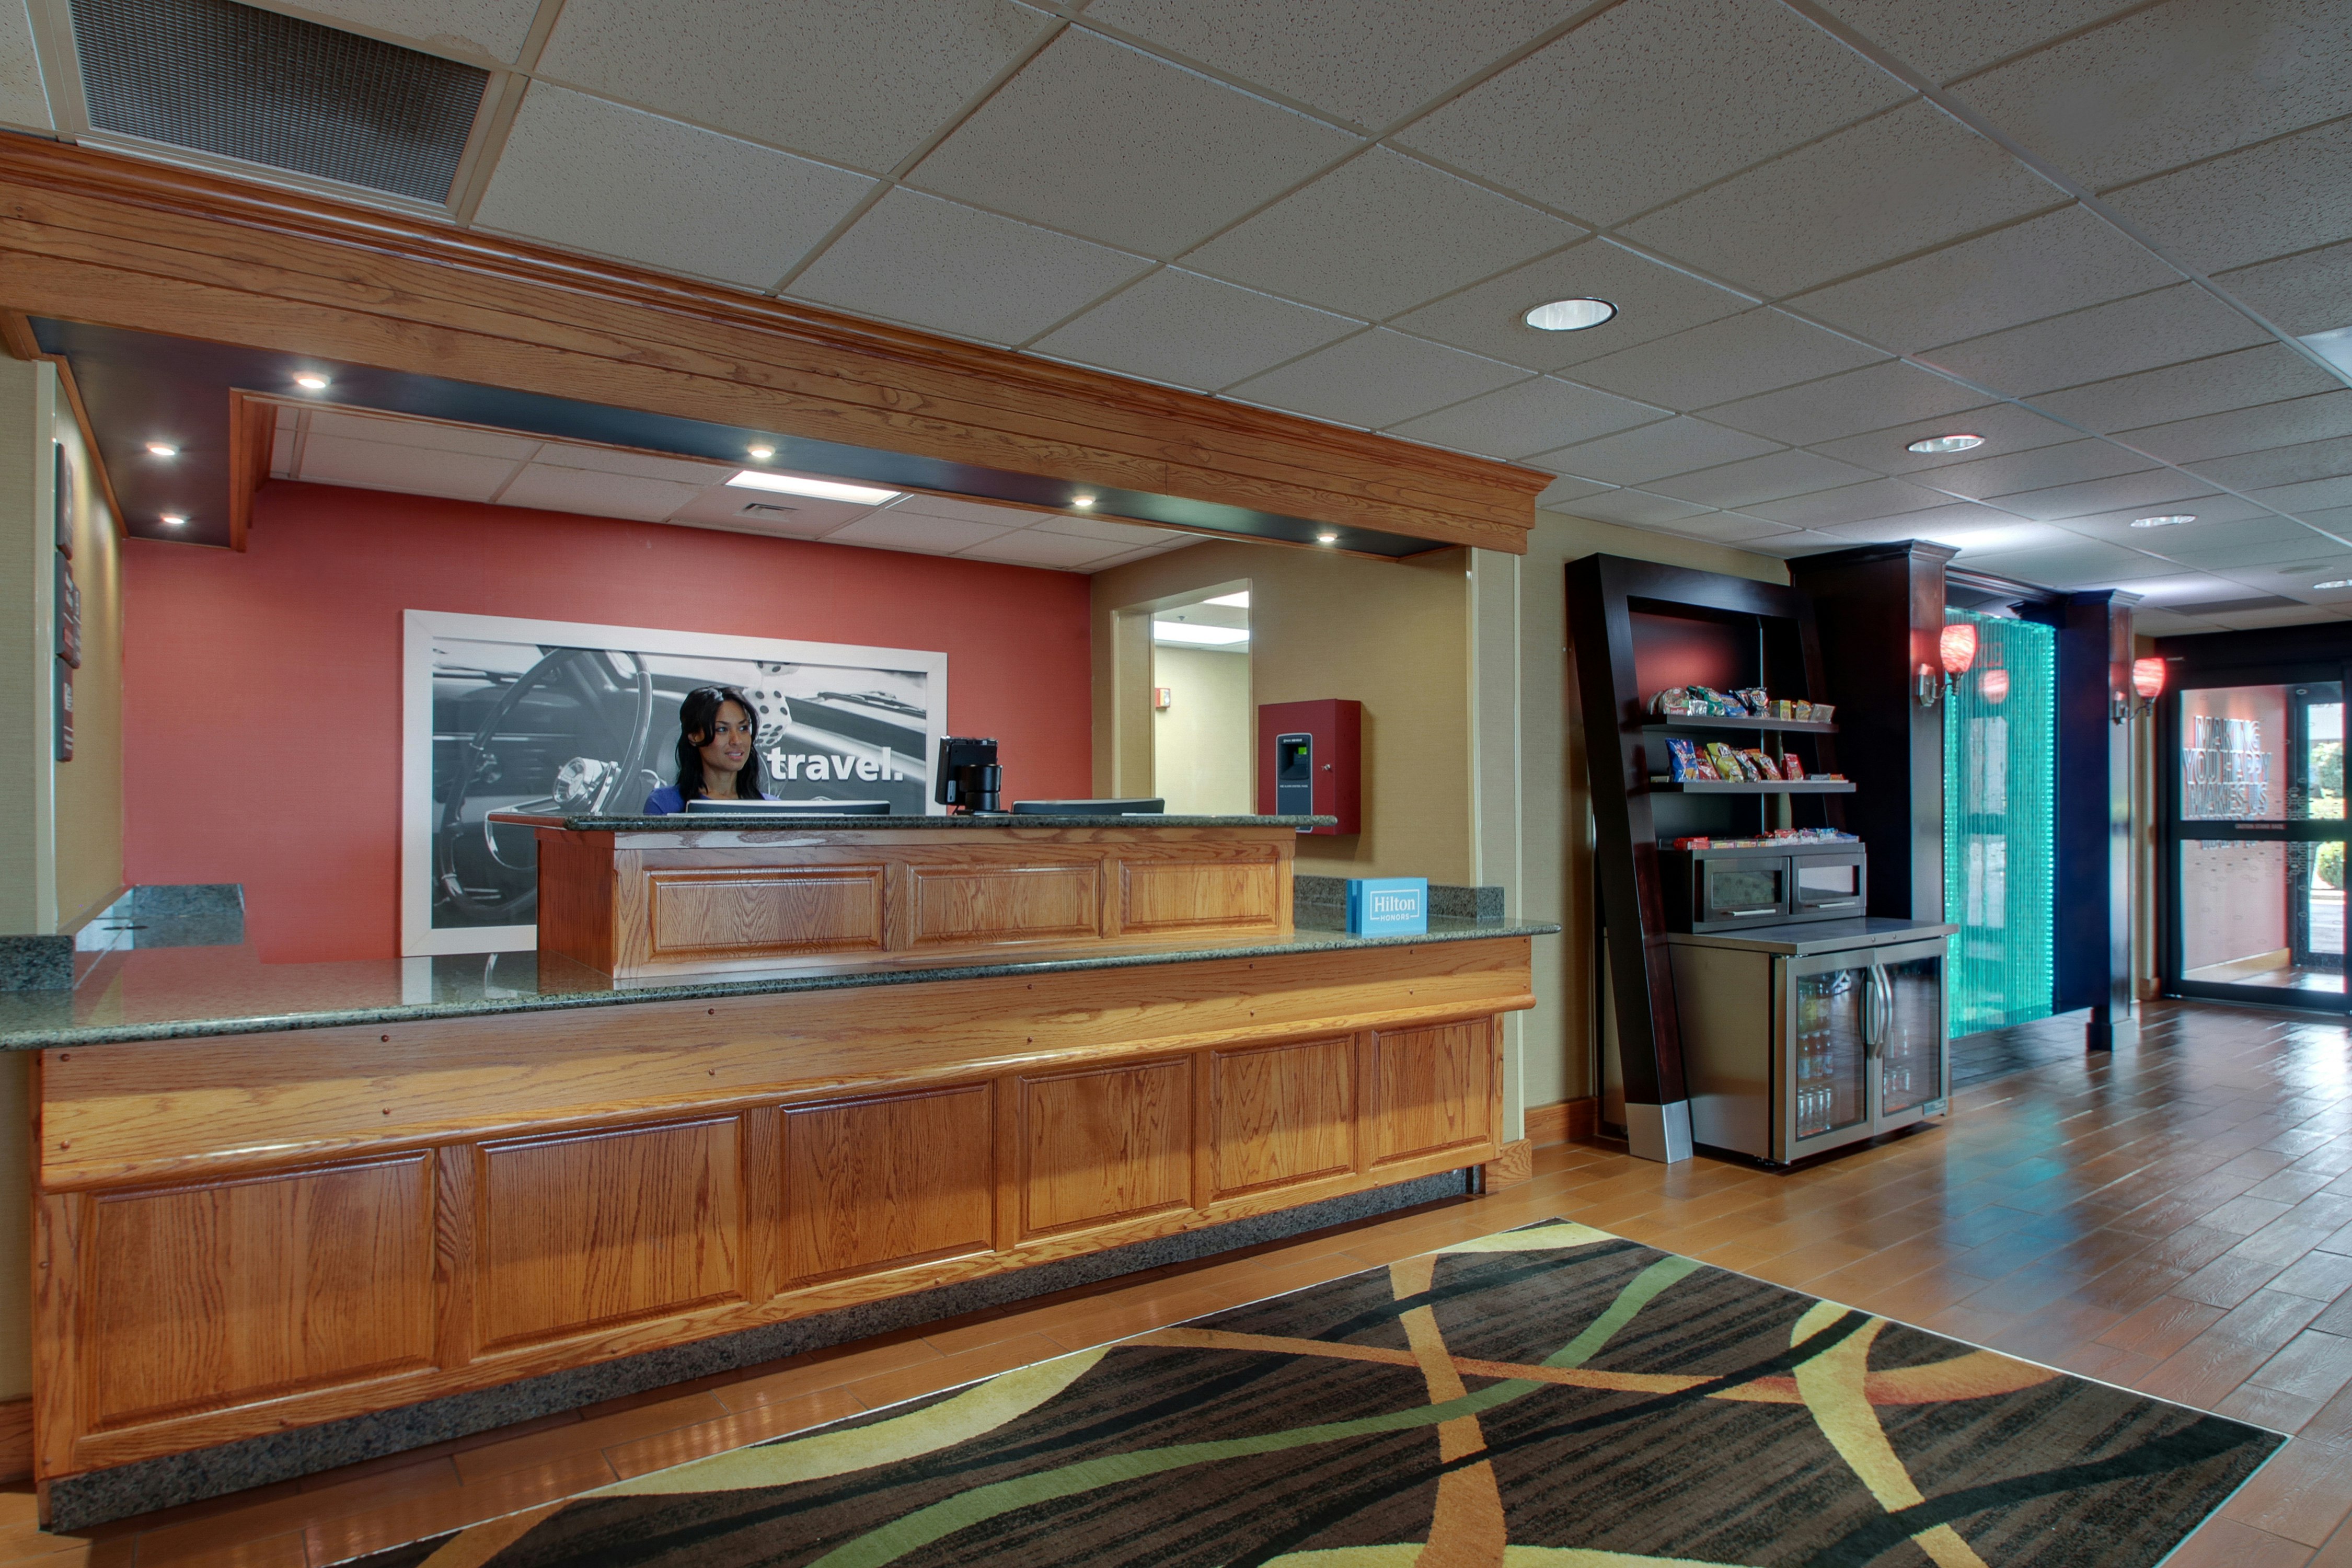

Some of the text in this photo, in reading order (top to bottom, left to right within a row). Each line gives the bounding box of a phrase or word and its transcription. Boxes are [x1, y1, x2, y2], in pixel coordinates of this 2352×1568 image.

[766, 746, 904, 782] travel.
[2183, 747, 2221, 785] YOU
[1375, 896, 1415, 912] Hilton
